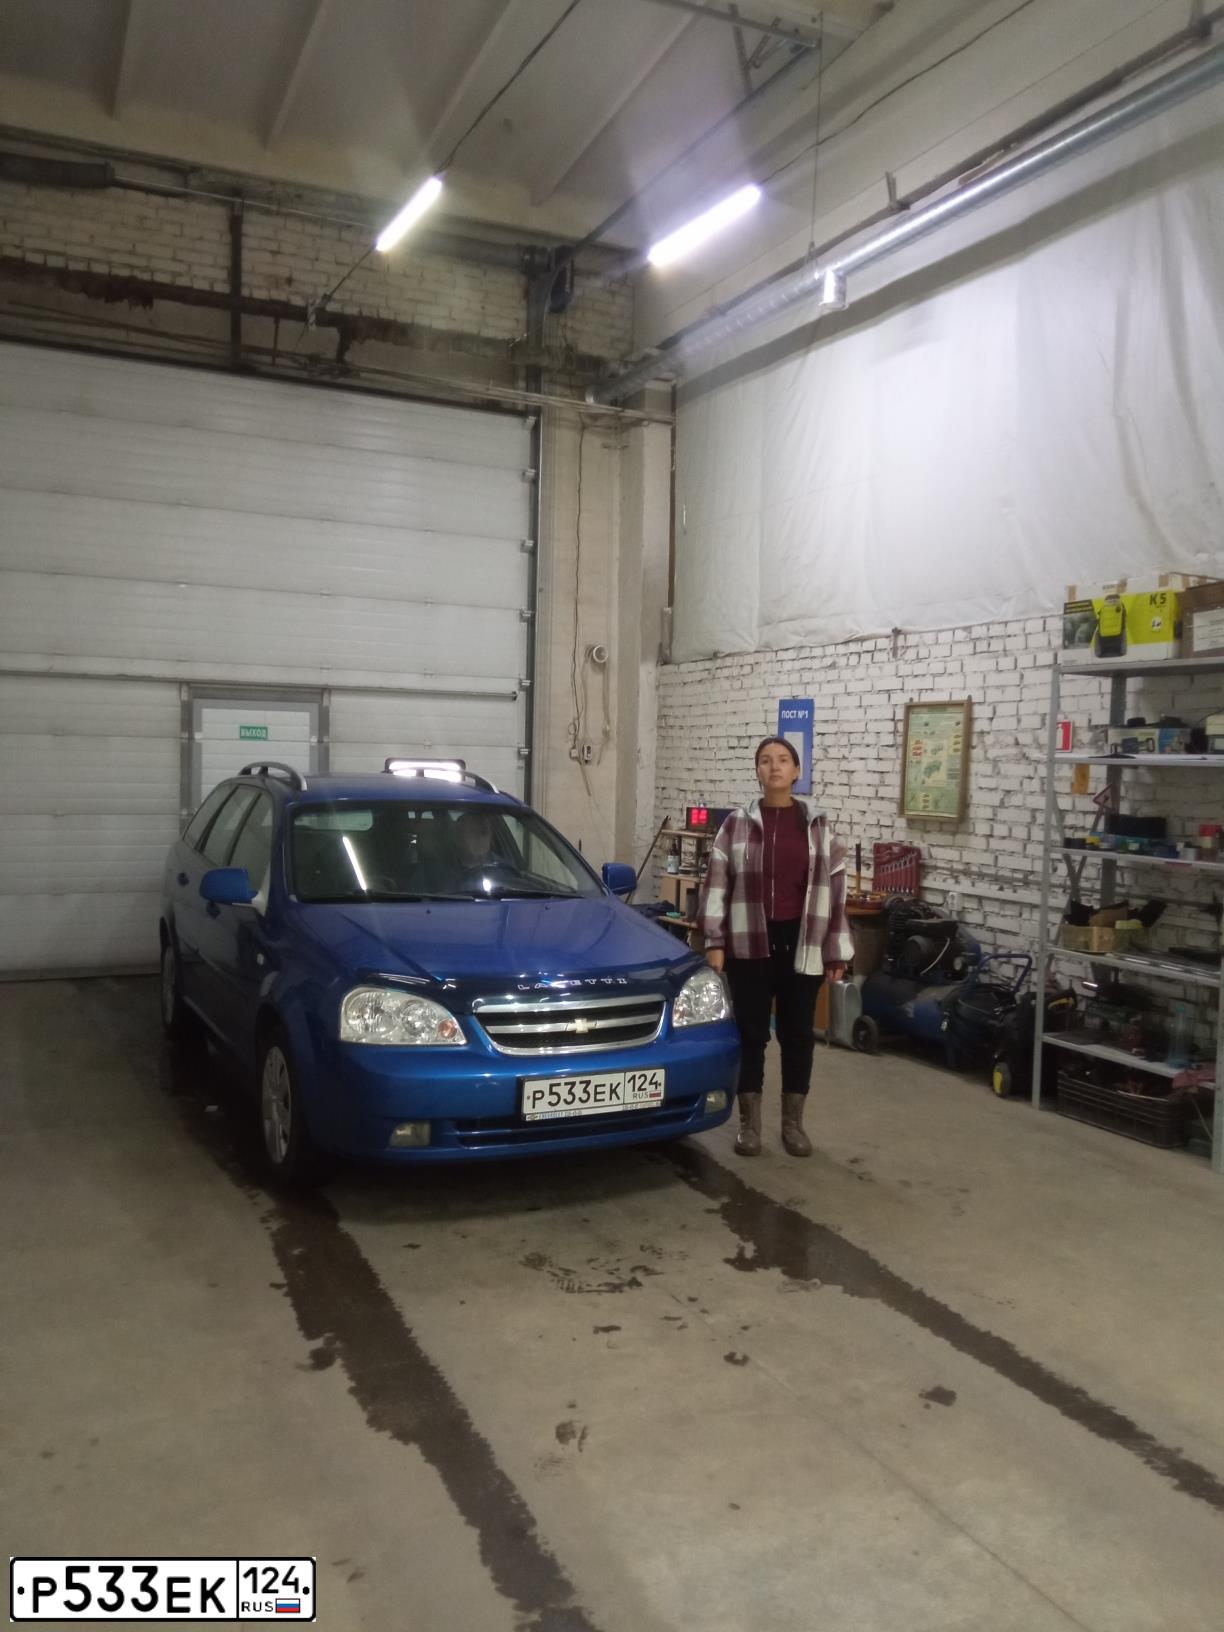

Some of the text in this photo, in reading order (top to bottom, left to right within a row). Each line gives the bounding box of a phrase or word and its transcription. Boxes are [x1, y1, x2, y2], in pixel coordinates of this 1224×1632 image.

[781, 710, 809, 719] ПОСТ №1
[240, 727, 267, 737] ВЫХОД
[627, 1072, 658, 1092] 124
[632, 1091, 649, 1100] RUS
